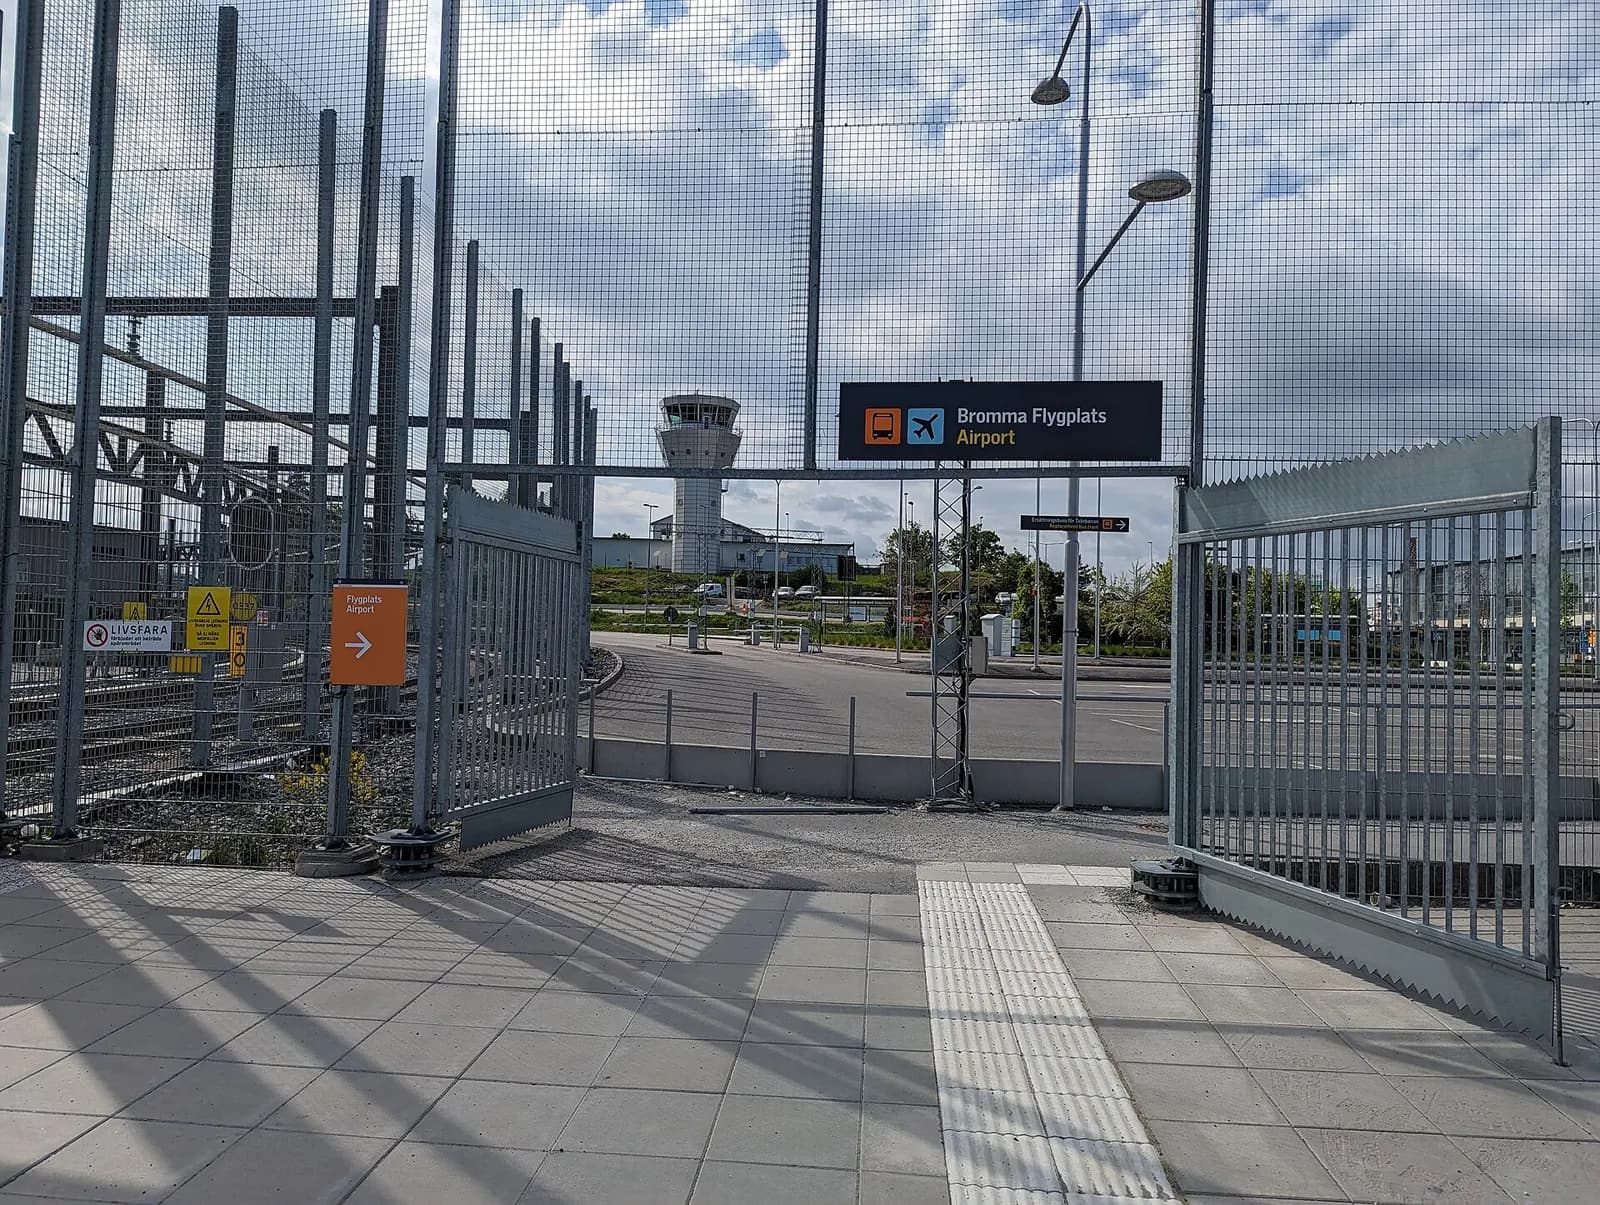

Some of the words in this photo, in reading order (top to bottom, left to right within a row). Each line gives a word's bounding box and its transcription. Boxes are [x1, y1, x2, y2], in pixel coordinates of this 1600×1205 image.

[957, 407, 1028, 424] Bromma
[1032, 407, 1107, 427] Flygplats
[956, 429, 1016, 448] Airport
[346, 594, 383, 605] Flygplats
[346, 604, 375, 615] Airport
[111, 625, 168, 635] LIVSFARA
